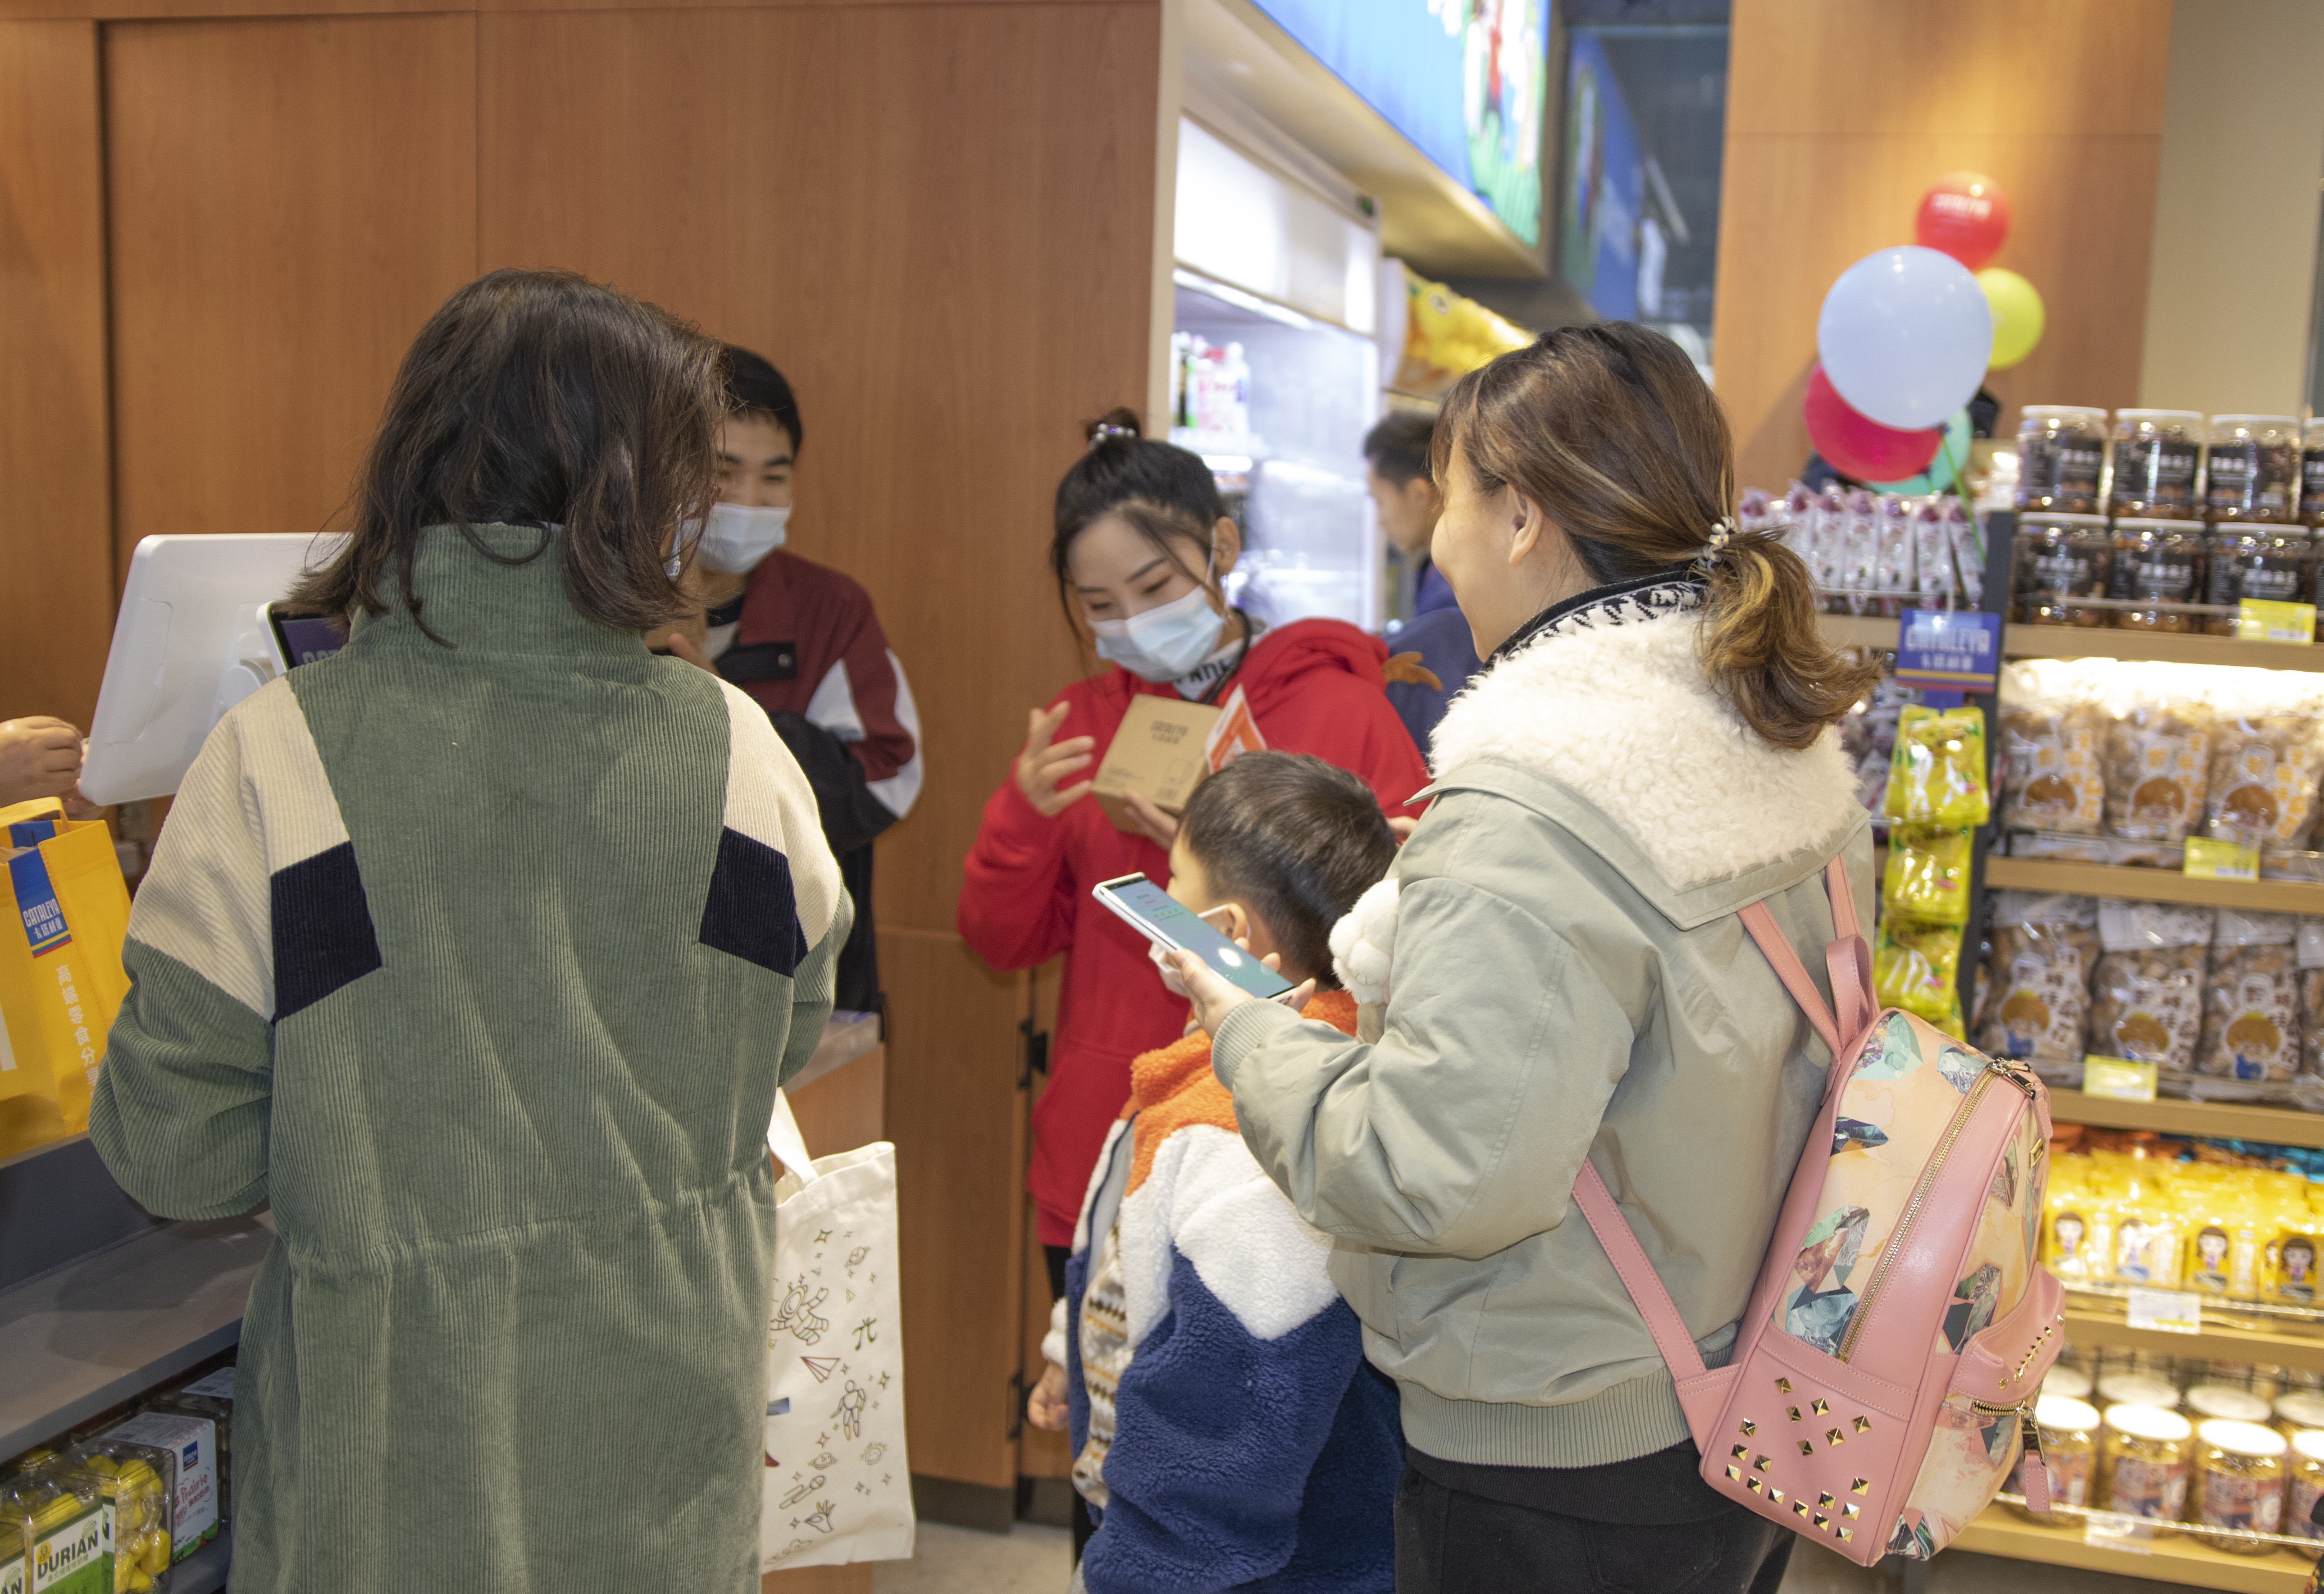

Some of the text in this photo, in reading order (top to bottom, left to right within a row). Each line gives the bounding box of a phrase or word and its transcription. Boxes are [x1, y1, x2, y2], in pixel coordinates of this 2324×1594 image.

[23, 898, 60, 927] CATALEYA
[55, 964, 99, 1097] 高端零食分享
[37, 1530, 98, 1580] DURIAN
